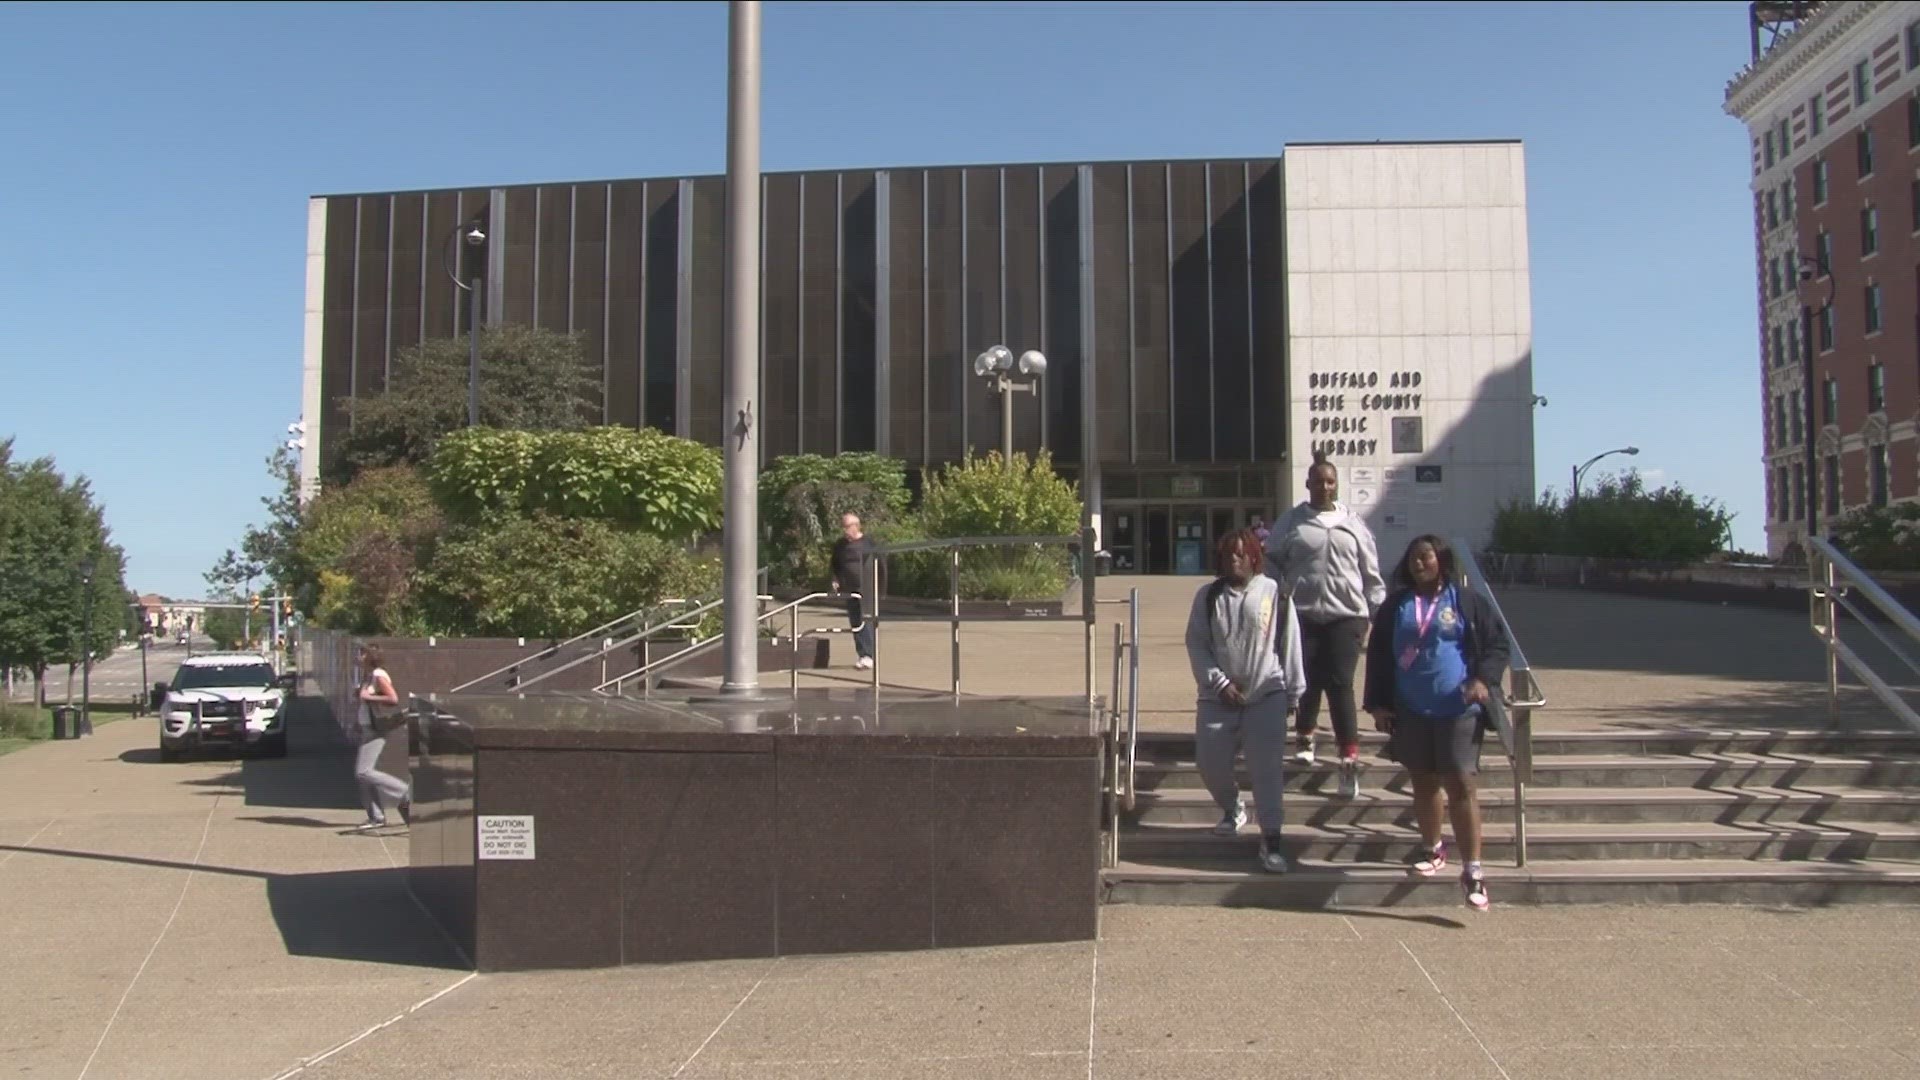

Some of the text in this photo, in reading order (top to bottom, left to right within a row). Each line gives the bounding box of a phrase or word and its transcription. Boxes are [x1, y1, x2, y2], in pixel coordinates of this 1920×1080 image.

[1309, 372, 1422, 388] BUFFALO AND
[1309, 394, 1422, 411] ERIE COUNTY
[1310, 417, 1367, 433] PUBLIC
[1311, 439, 1377, 456] LIBRARY
[486, 820, 525, 828] CAUTION
